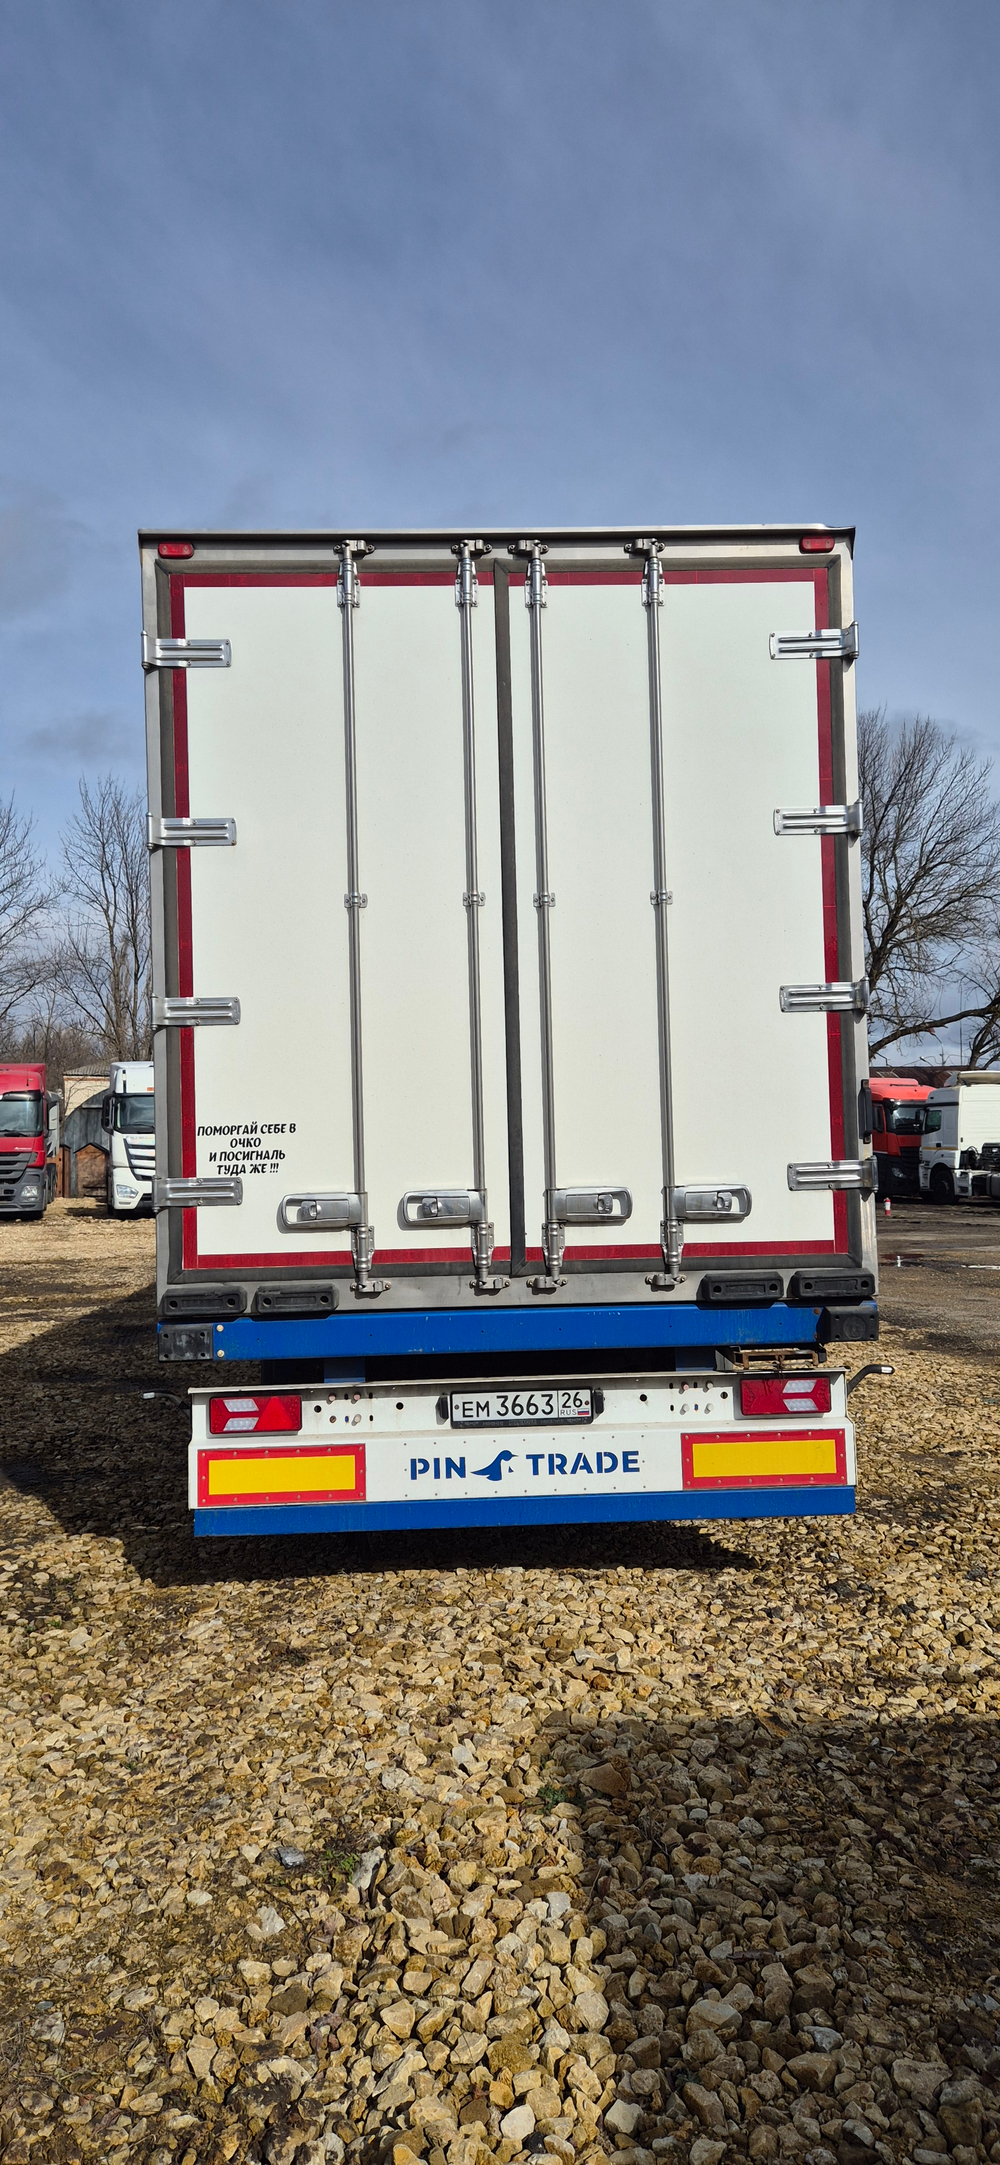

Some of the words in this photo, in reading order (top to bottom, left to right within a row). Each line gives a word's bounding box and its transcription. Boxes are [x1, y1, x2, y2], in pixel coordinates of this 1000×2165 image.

[197, 1121, 258, 1136] ПОМОРГАЙ
[260, 1123, 287, 1135] СЕБЕ
[289, 1123, 297, 1133] В
[230, 1137, 262, 1148] ОЧКО
[209, 1151, 217, 1162] И
[219, 1150, 286, 1161] ПОСИГНАЛЬ
[217, 1164, 246, 1176] ТУДА
[249, 1163, 267, 1174] ЖЕ
[496, 1393, 554, 1417] 3663
[561, 1391, 583, 1409] 26
[410, 1456, 466, 1480] PIN
[525, 1450, 640, 1476] TRADE
